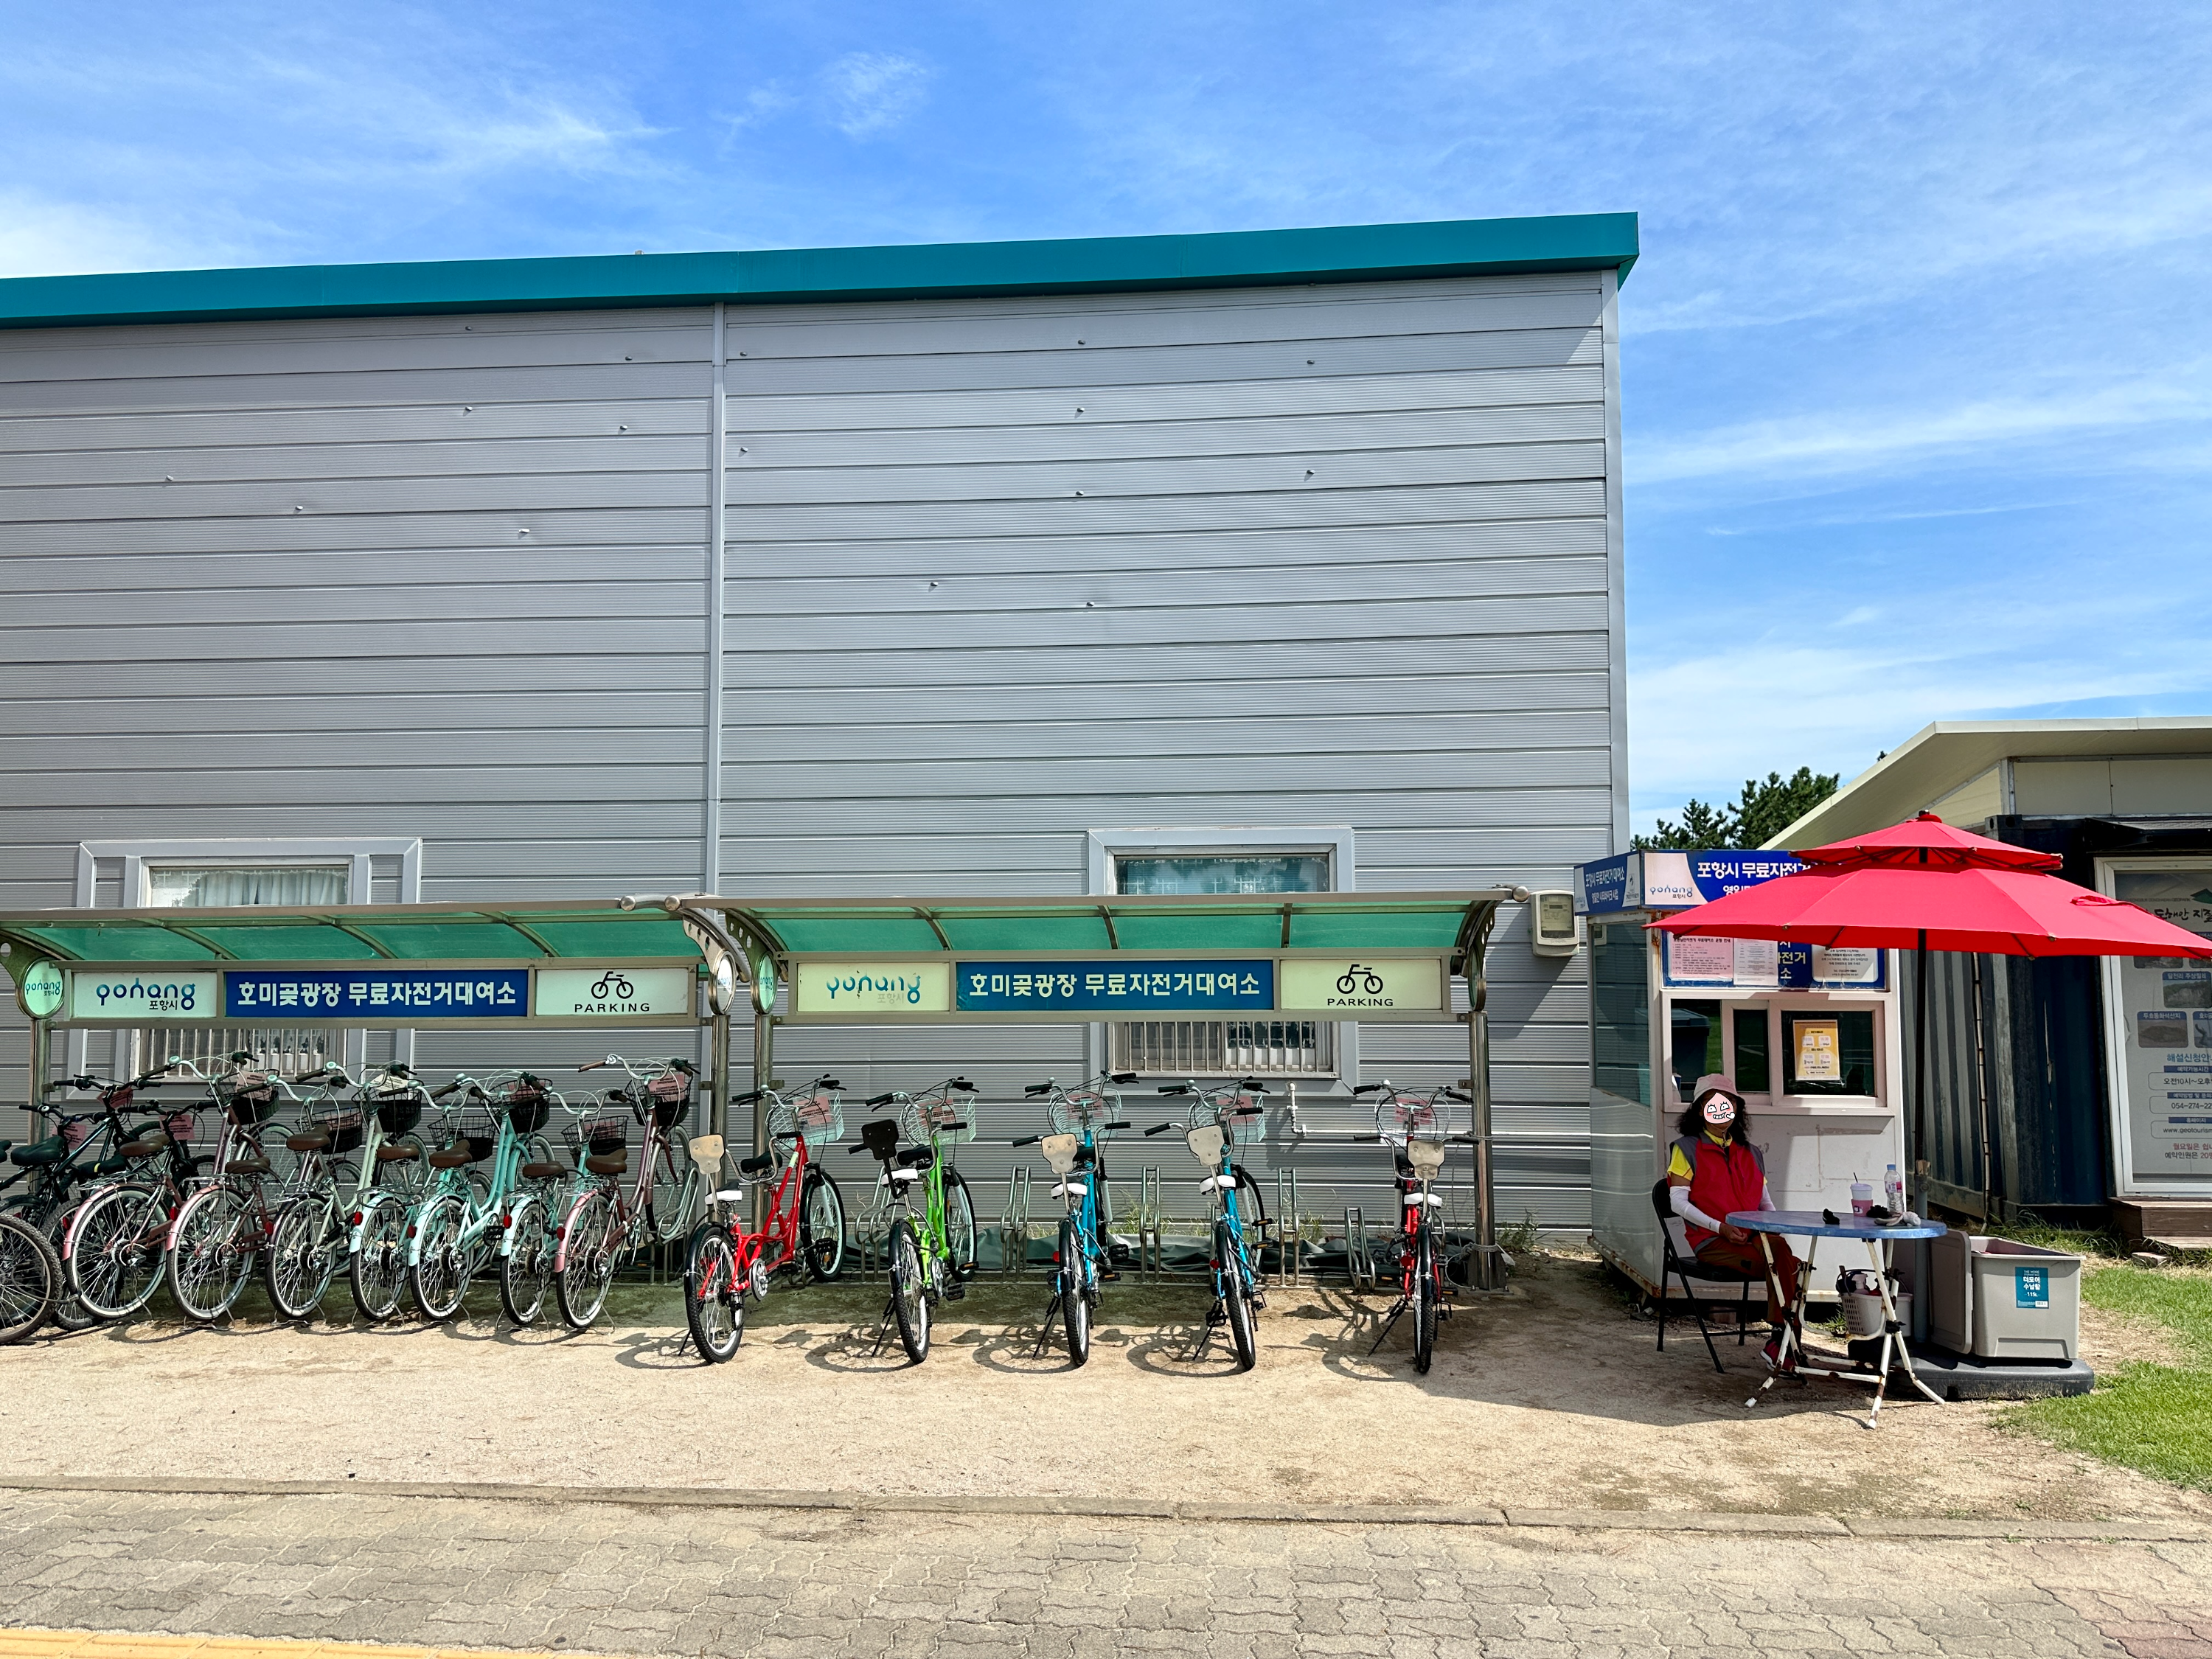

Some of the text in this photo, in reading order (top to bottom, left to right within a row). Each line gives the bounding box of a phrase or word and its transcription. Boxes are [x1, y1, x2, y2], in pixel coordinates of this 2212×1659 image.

[1697, 862, 1739, 879] 포항시
[1585, 872, 1596, 888] 포항시
[1613, 866, 1625, 883] 대여소
[970, 973, 1261, 998] 호미곶광장 무료자전거대여소
[96, 978, 195, 1010] pohang
[237, 981, 516, 1006] 호미곶광장 무료자전거대여소
[877, 993, 904, 1004] 포항시
[149, 1000, 178, 1010] 포항시
[1327, 998, 1394, 1006] PARKING
[574, 1003, 650, 1013] PARKING
[2166, 1053, 2212, 1062] 해설신청안
[2163, 1077, 2212, 1085] 오전10시~오후
